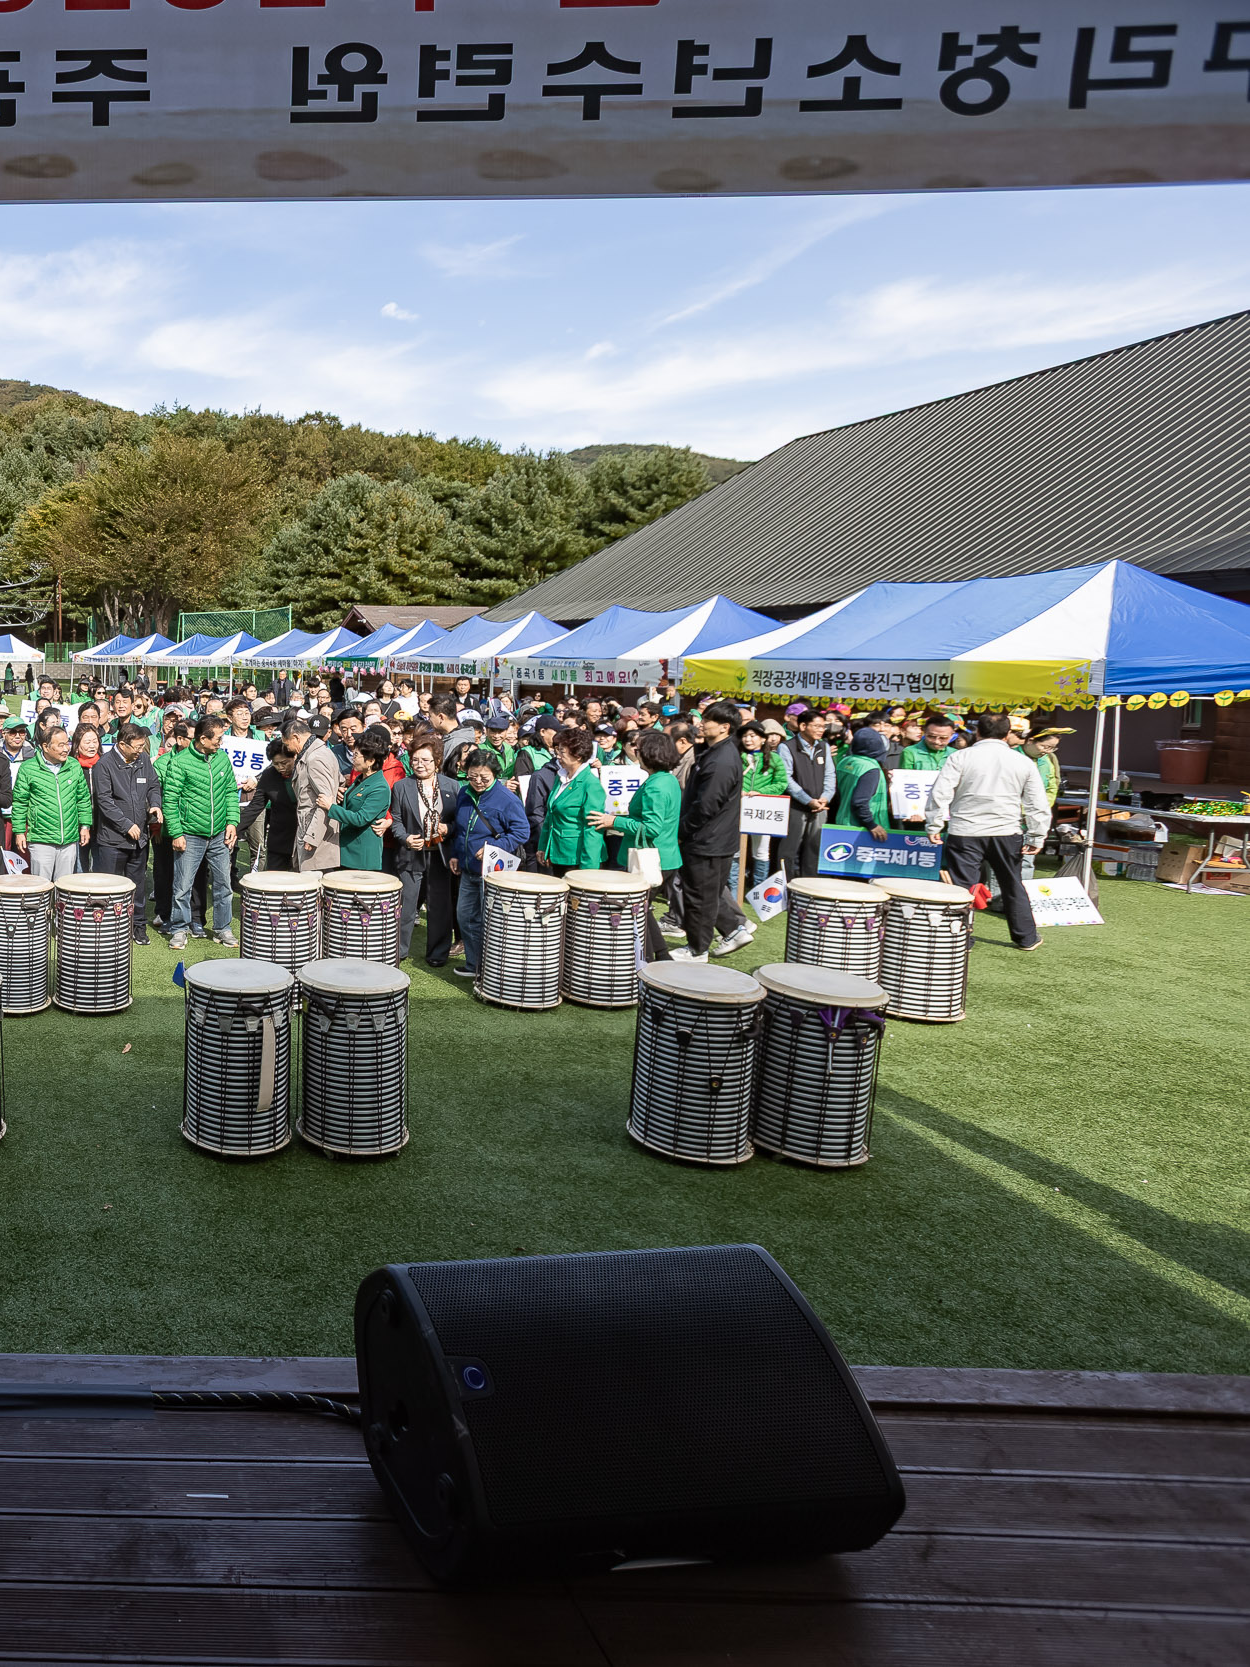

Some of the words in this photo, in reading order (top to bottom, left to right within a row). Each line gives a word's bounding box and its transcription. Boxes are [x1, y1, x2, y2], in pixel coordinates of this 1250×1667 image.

[516, 667, 545, 681] 중곡1동
[551, 669, 578, 682] 새마을
[584, 670, 631, 684] 최고예요!
[751, 669, 955, 695] 직장공장새마을운동광진구협의회
[219, 747, 264, 771] 장동
[855, 845, 937, 868] 중곡제1동
